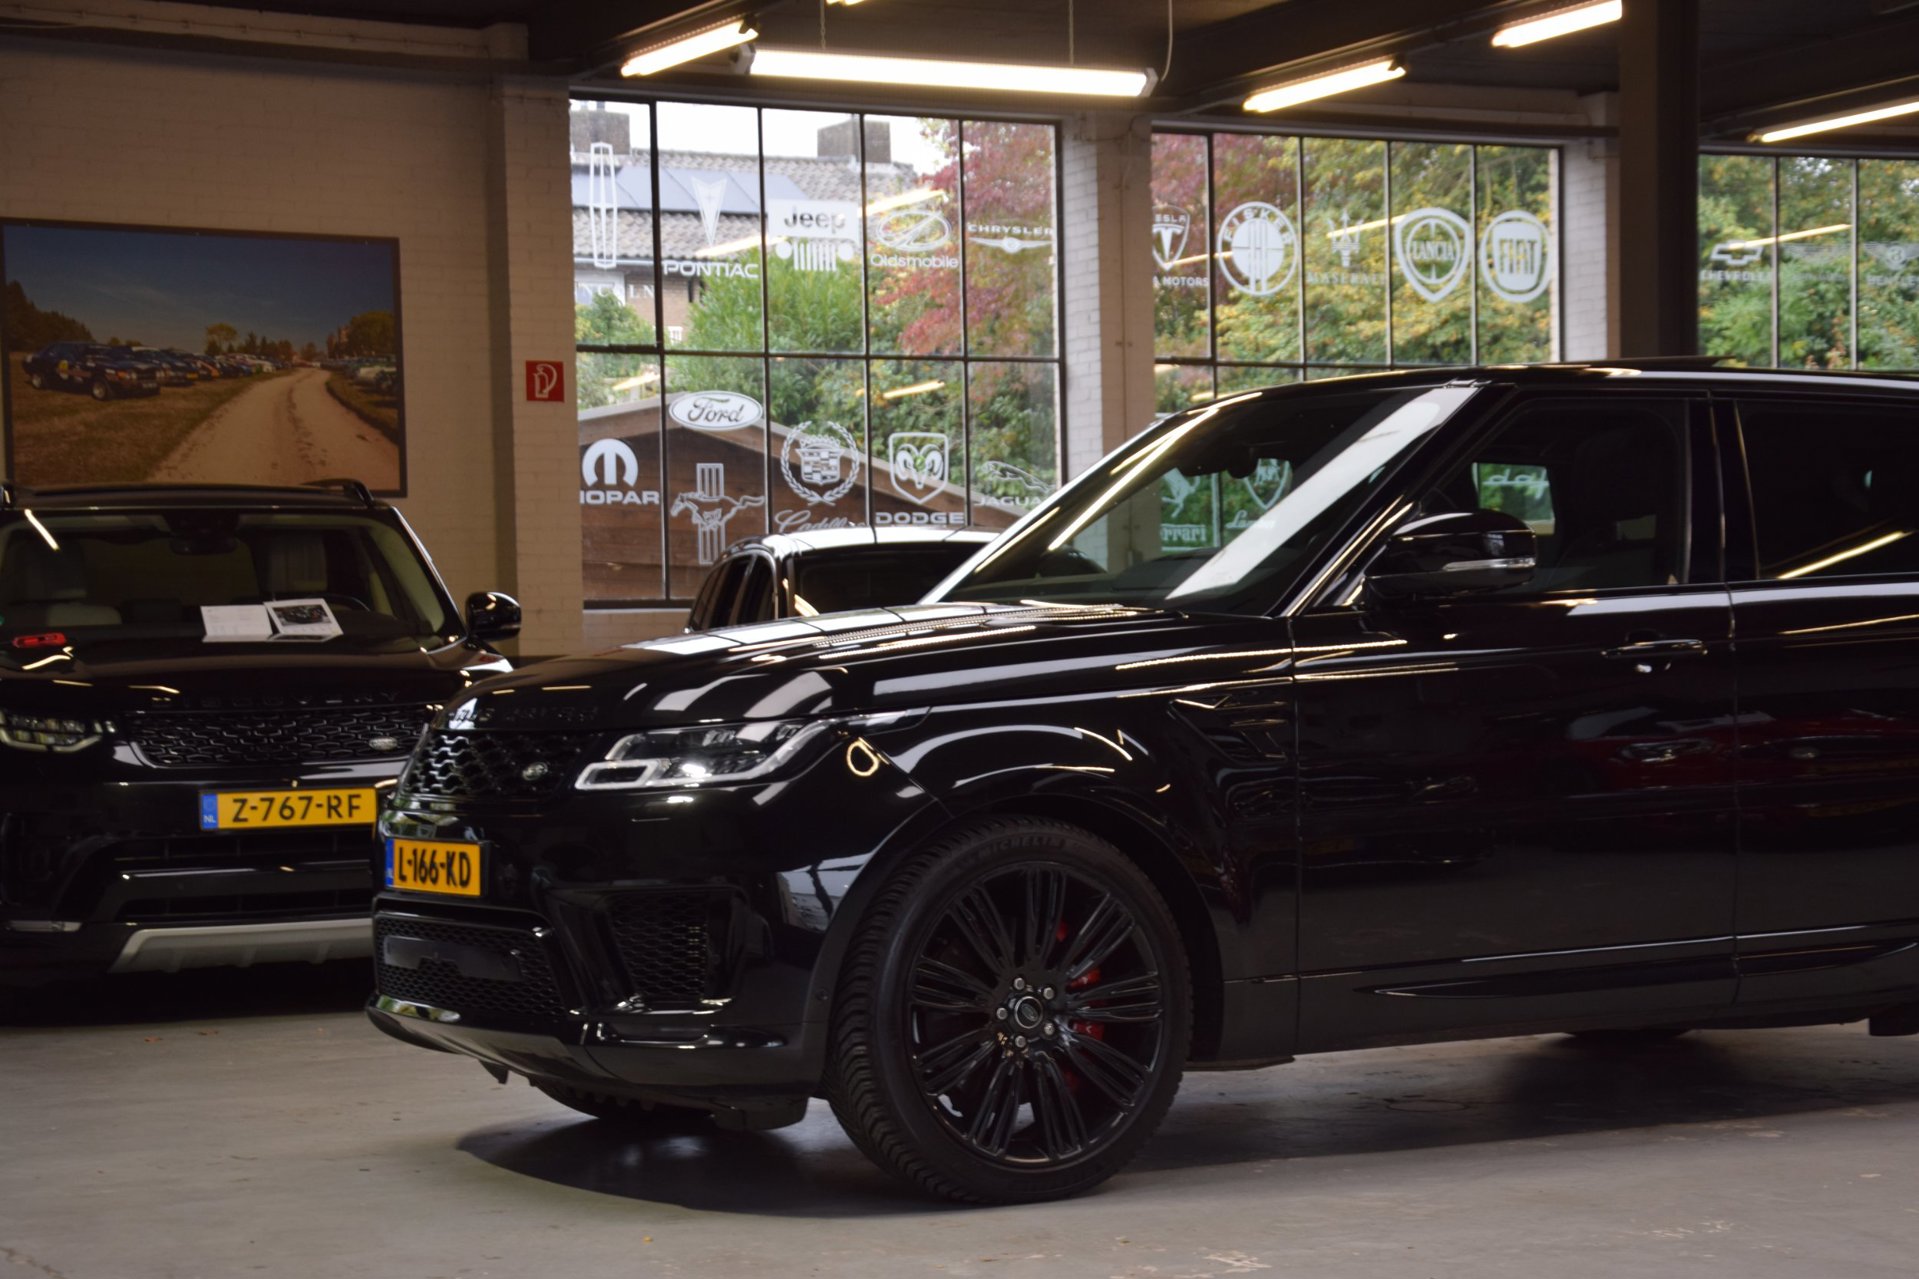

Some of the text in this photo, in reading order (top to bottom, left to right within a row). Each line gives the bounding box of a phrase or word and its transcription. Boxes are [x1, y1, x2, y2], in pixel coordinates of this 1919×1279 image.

[784, 206, 846, 235] Jeep
[1154, 213, 1187, 222] ESLA
[1410, 239, 1456, 261] LANCIA
[1498, 238, 1538, 275] FIAT
[662, 260, 759, 278] PONTIAC
[870, 253, 960, 269] Oldsmobile
[687, 396, 745, 423] Ford
[974, 496, 1045, 507] JAGUA
[875, 512, 965, 525] DODGE
[232, 794, 362, 823] Z-767-RF
[203, 815, 216, 824] NL
[398, 847, 472, 888] L-166-KD
